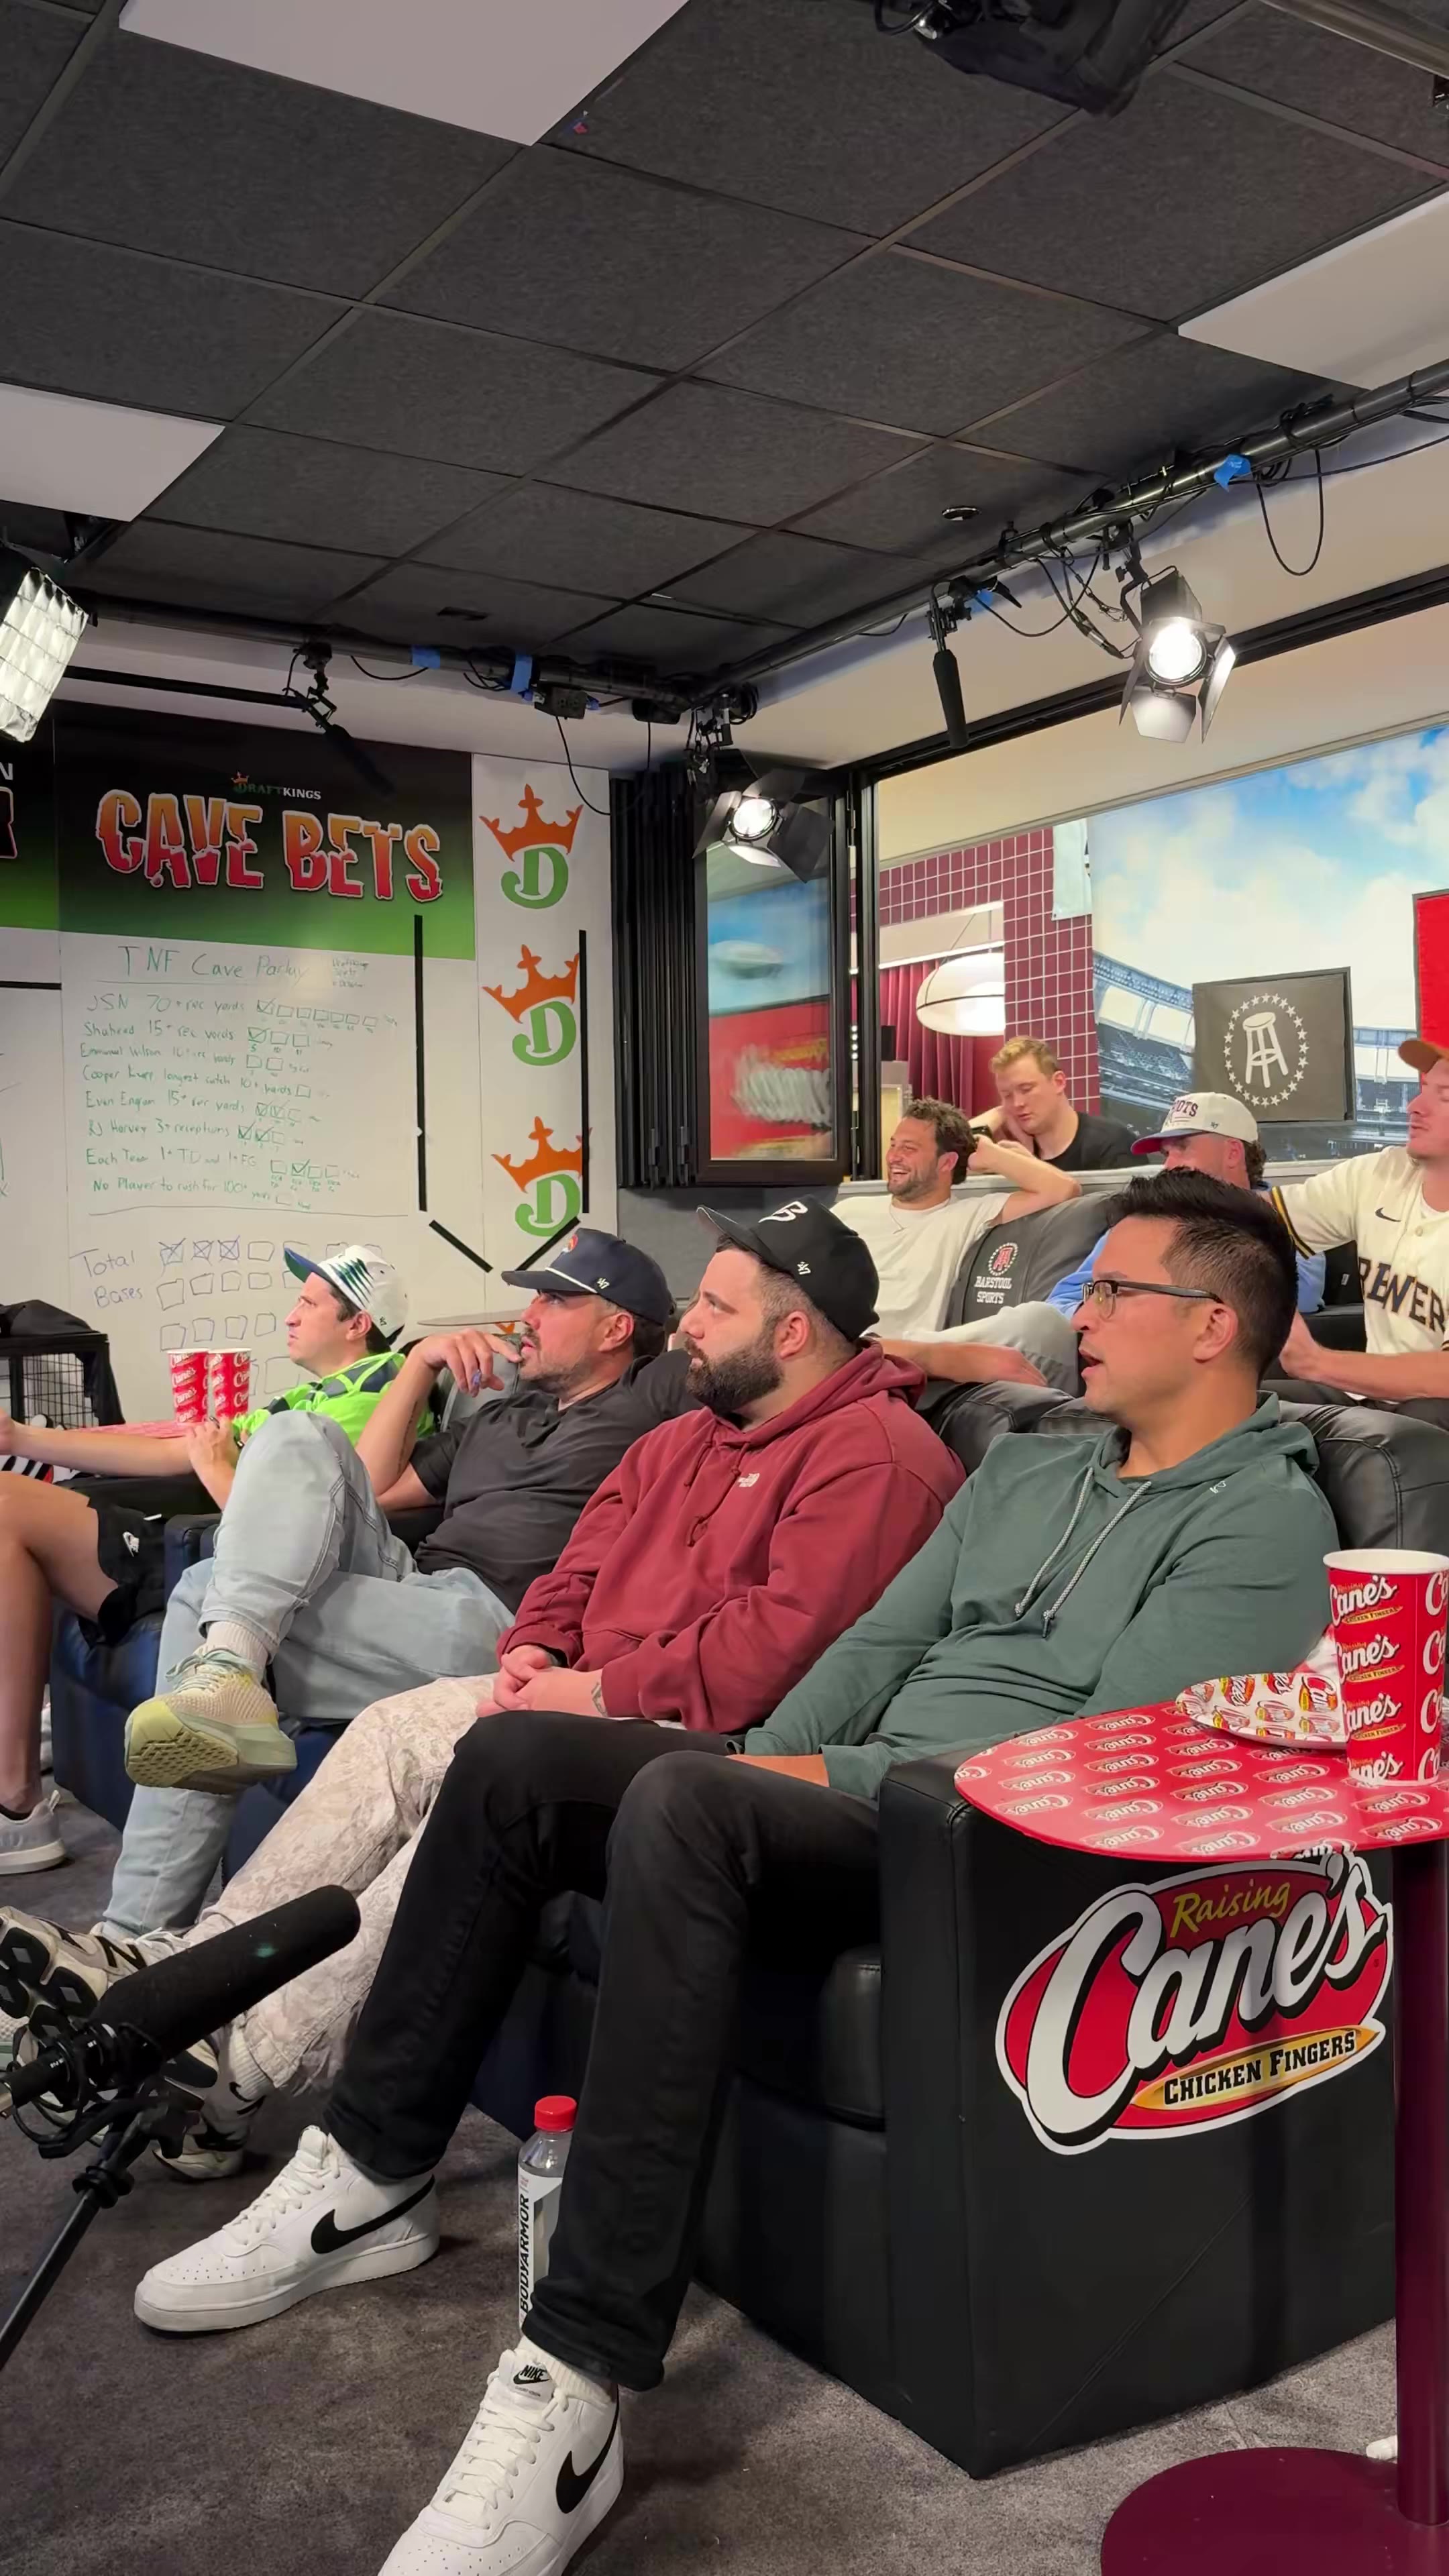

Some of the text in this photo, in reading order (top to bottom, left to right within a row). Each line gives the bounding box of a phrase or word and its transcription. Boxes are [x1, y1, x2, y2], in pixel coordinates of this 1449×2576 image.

[96, 790, 264, 888] CAVE
[282, 810, 442, 903] BETS
[118, 946, 180, 977] TNF
[191, 953, 244, 978] Cave
[87, 994, 128, 1012] JSN
[86, 1148, 118, 1165] Each
[94, 1180, 109, 1192] No
[160, 1177, 172, 1191] to
[70, 1248, 136, 1277] Total
[95, 1285, 143, 1307] Bases
[974, 1276, 1012, 1289] BARSTOOL
[976, 1291, 1005, 1304] SPORTS
[1330, 1574, 1398, 1627] Cane's
[1170, 1879, 1291, 1938] Raising
[1026, 1853, 1385, 2135] Cane's
[1163, 2031, 1356, 2106] CHICKEN FINGERS
[519, 2194, 529, 2313] BODYARMOR
[520, 2365, 548, 2381] NIKE
